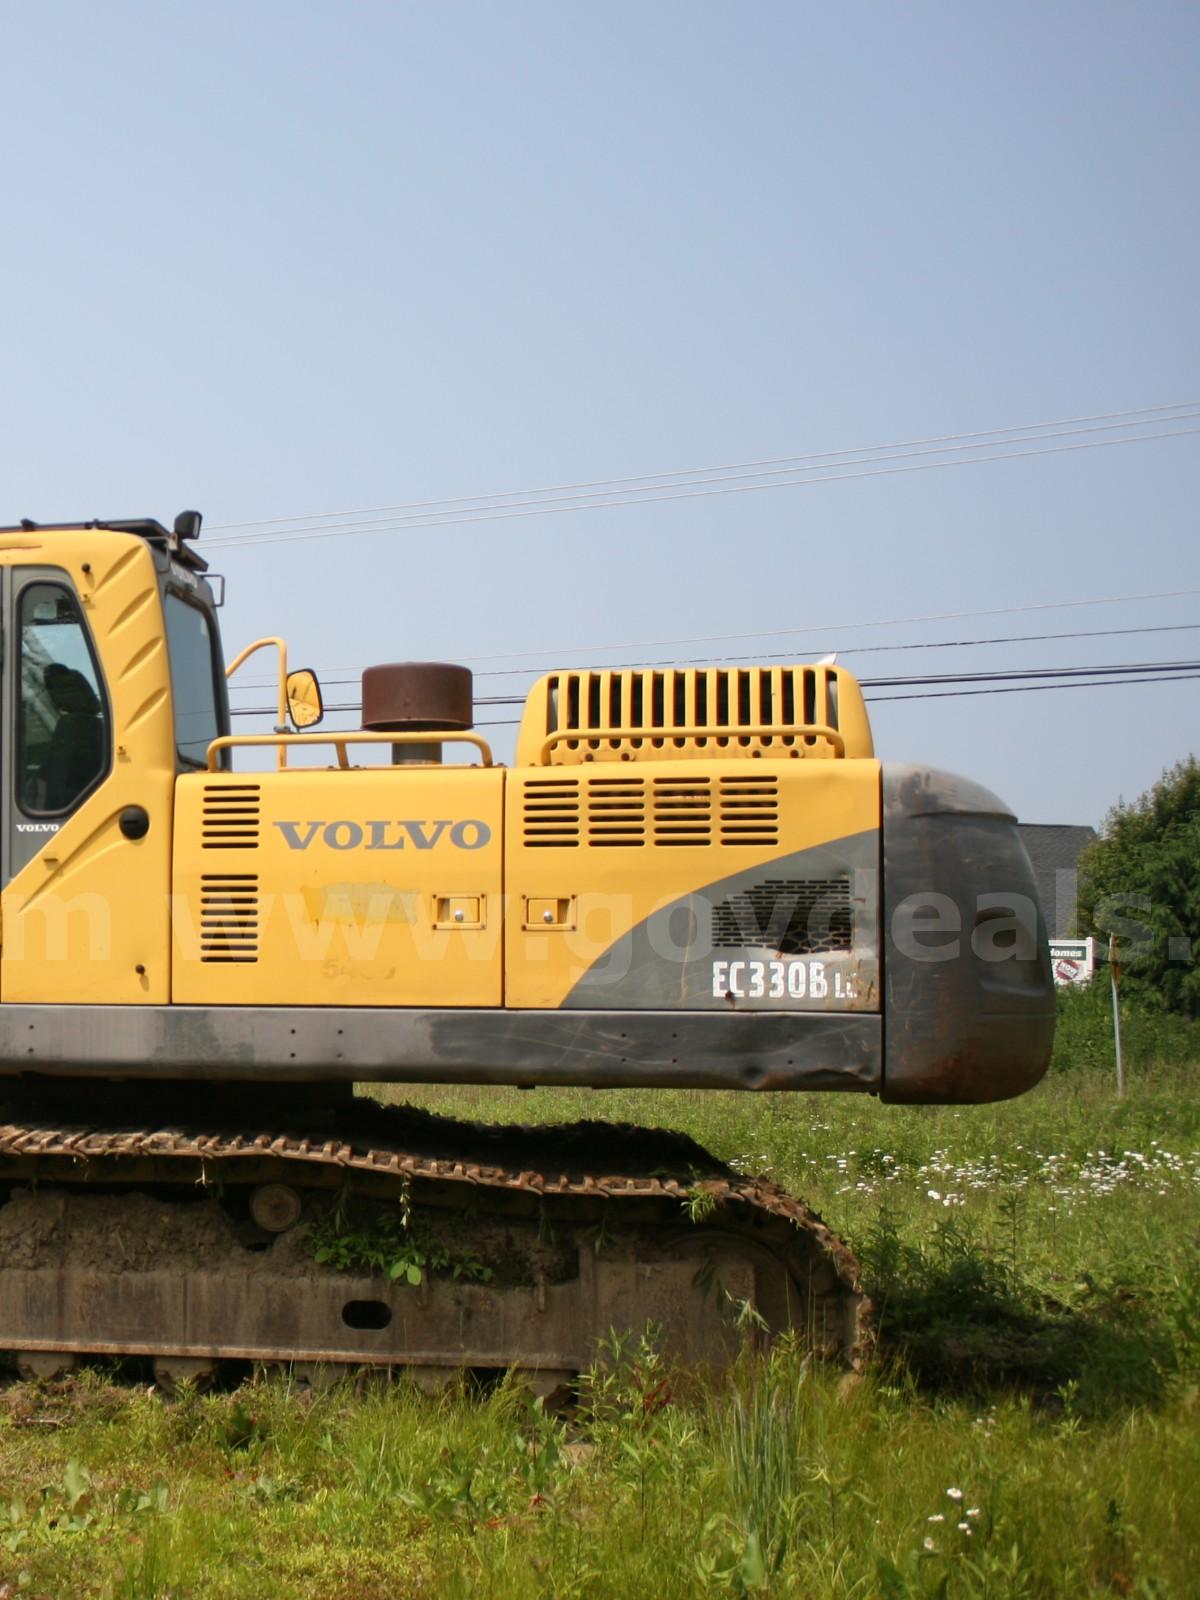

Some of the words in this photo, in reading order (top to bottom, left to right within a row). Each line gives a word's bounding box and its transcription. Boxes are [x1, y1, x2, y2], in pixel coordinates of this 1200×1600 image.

[15, 823, 60, 833] VOLVO
[271, 819, 492, 850] VOLVO
[712, 961, 828, 999] EC330B
